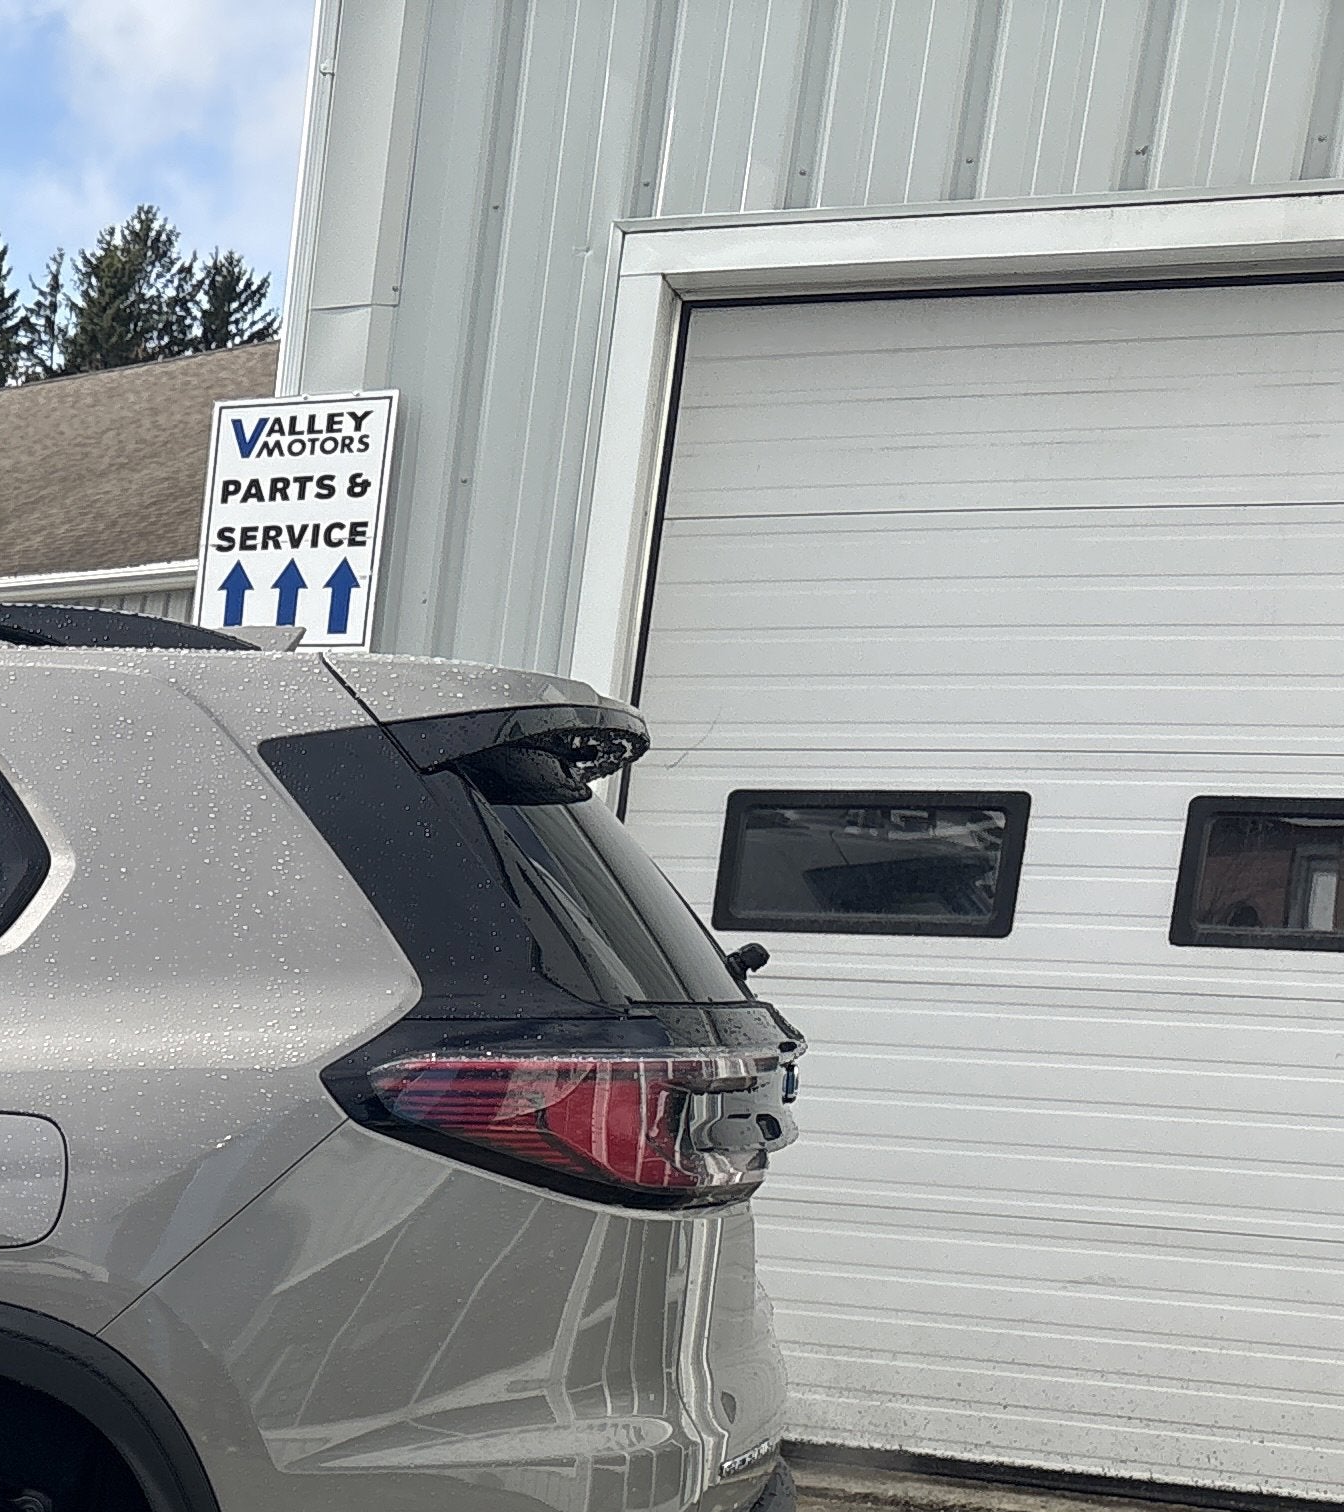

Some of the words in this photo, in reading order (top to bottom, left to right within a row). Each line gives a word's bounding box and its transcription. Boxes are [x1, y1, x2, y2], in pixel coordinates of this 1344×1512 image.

[230, 409, 374, 459] VALLEY
[255, 434, 370, 459] MOTORS
[220, 475, 336, 504] PARTS
[346, 472, 372, 498] &
[215, 521, 369, 552] SERVICE
